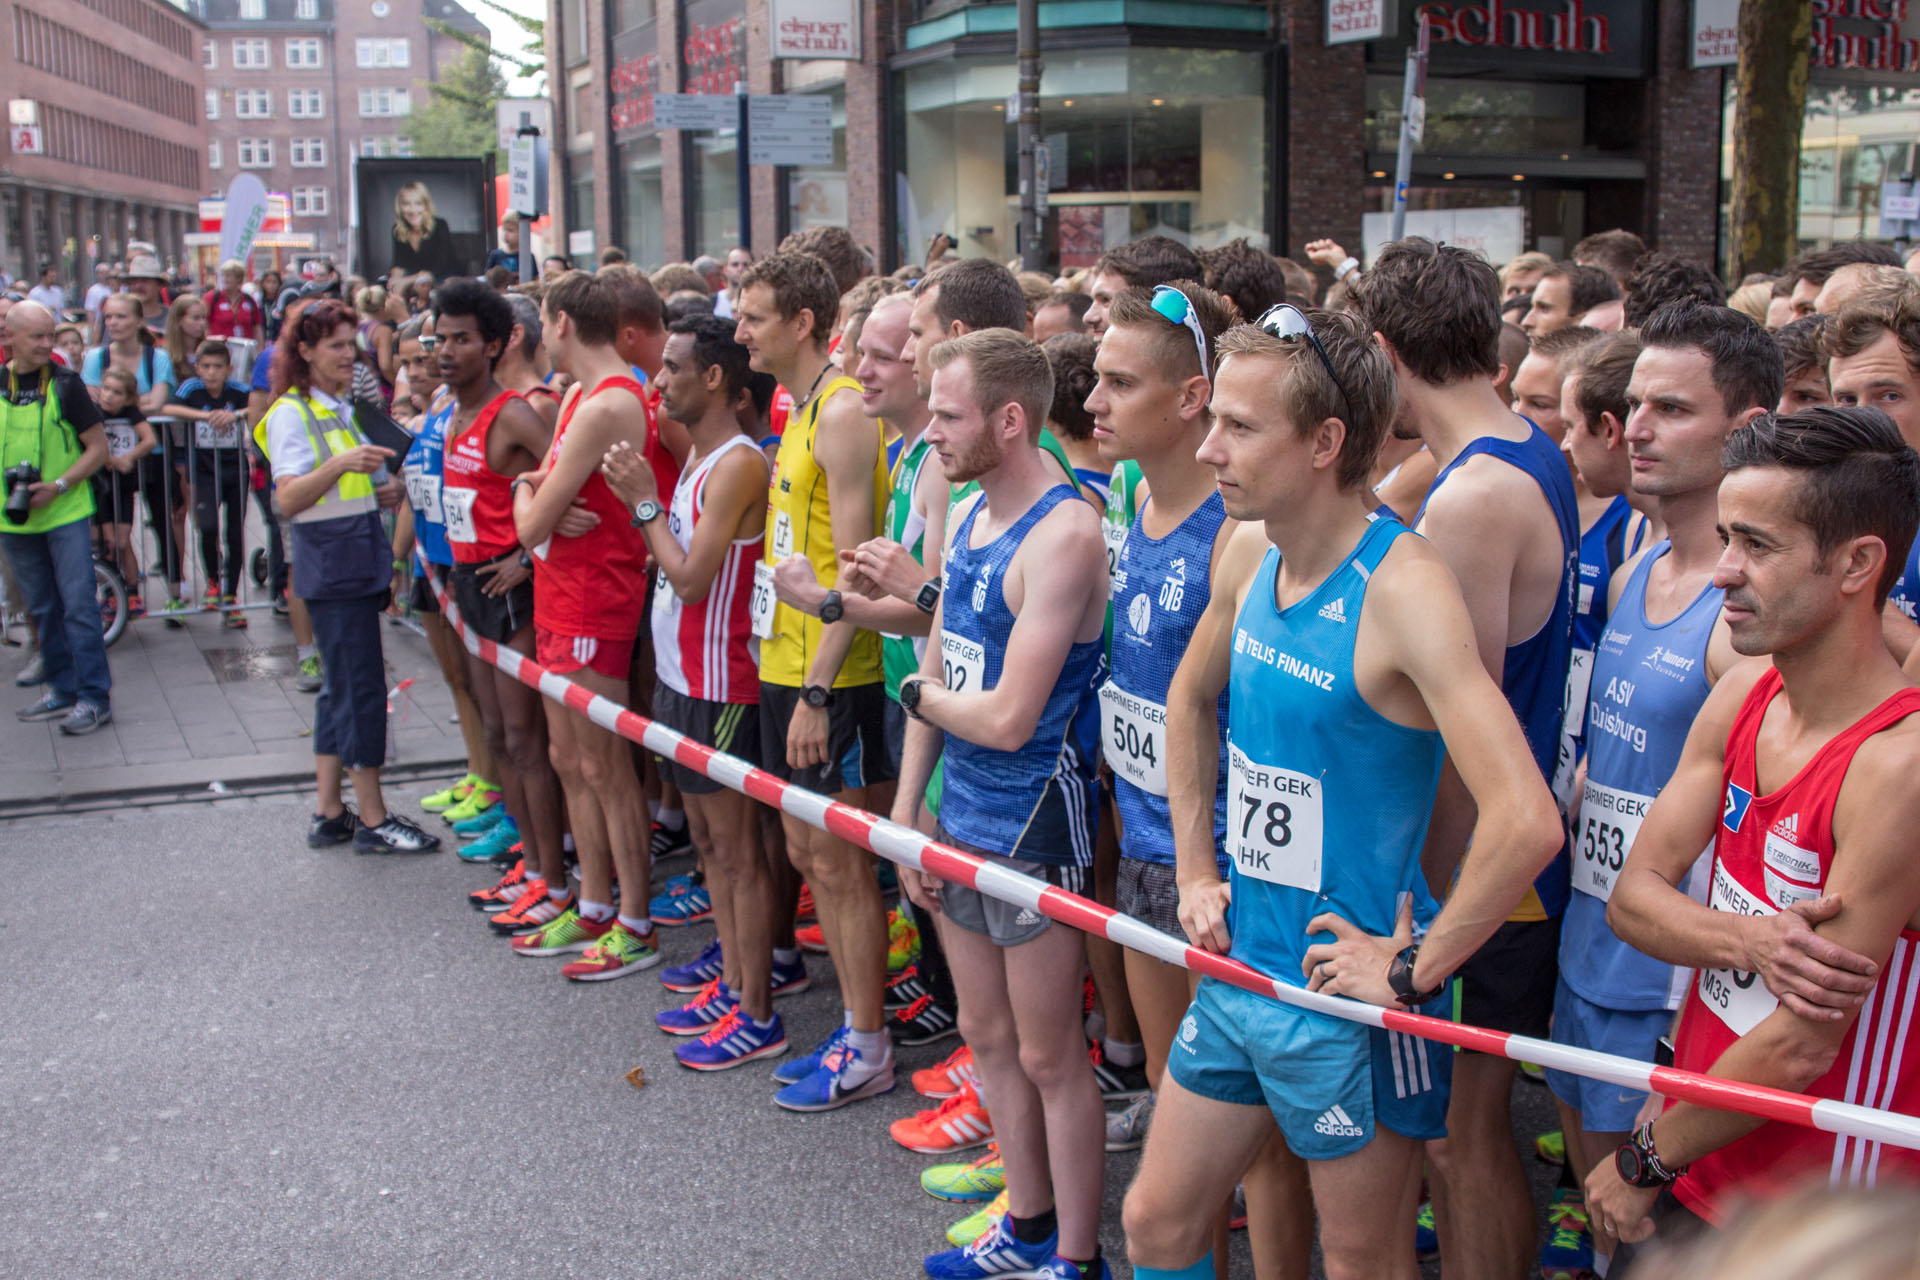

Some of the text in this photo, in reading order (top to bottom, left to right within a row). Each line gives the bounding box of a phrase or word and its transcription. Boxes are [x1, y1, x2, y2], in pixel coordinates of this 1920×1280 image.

[781, 32, 848, 51] schuh
[1415, 0, 1613, 53] schuh
[1159, 576, 1185, 611] OTB
[1318, 609, 1346, 624] adidas
[962, 645, 982, 663] GEK
[1246, 637, 1335, 692] TELIS FINANZ
[1603, 677, 1636, 707] ASV
[1143, 706, 1167, 727] GEK
[1591, 701, 1647, 752] Duisburg
[1114, 714, 1157, 769] 504
[1126, 761, 1146, 781] MHK
[1274, 776, 1312, 799] GEK
[1584, 786, 1646, 818] BARMER GEK
[1584, 818, 1624, 872] 553
[1773, 824, 1798, 843] adidas
[1702, 967, 1731, 1008] M35
[1314, 1121, 1363, 1137] adidas
